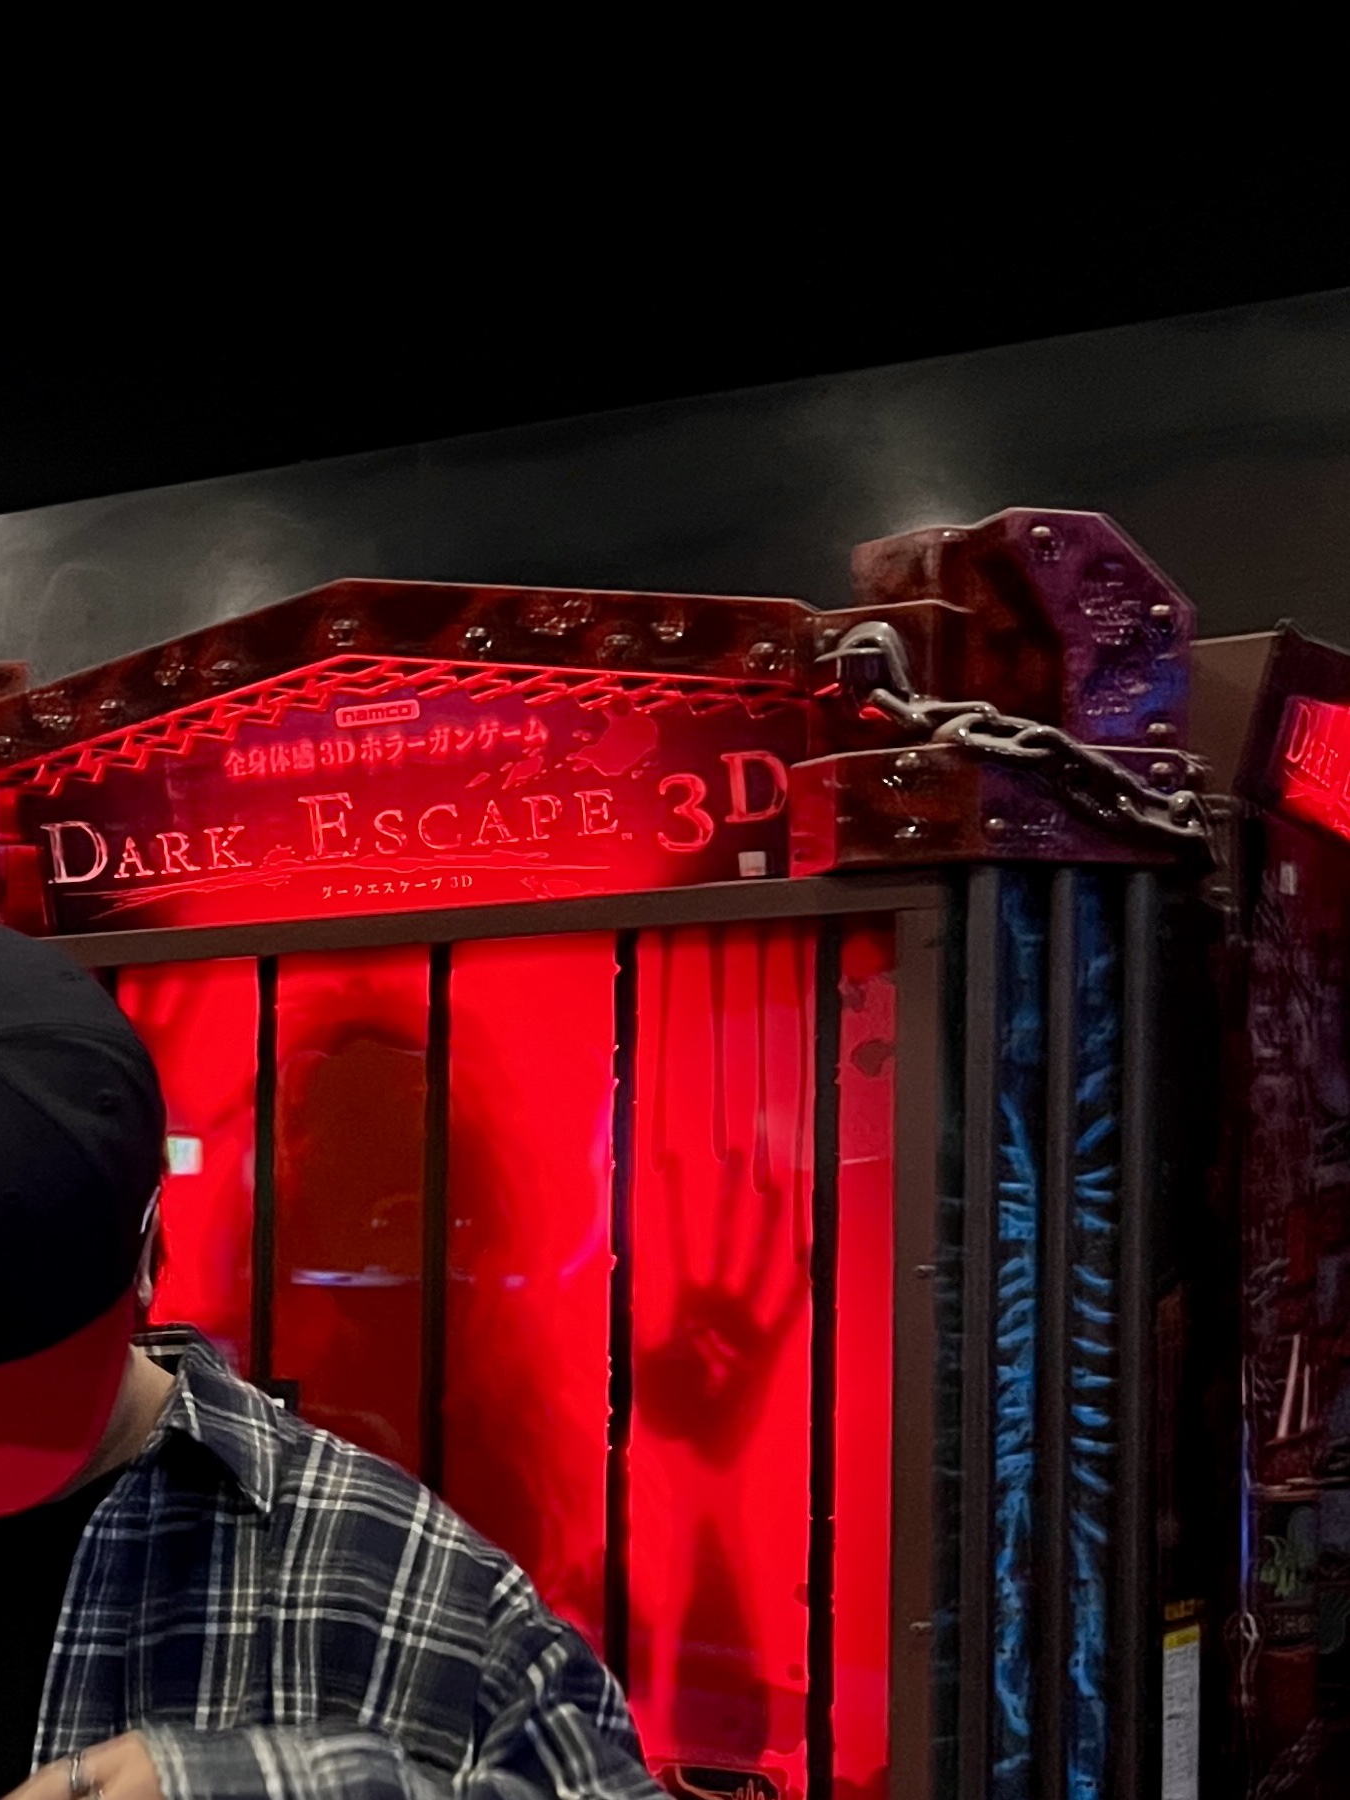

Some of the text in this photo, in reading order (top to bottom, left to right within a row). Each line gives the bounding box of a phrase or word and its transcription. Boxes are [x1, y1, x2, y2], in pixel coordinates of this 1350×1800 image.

[342, 703, 412, 724] namco
[40, 750, 788, 885] DARK ESCAPE 3D
